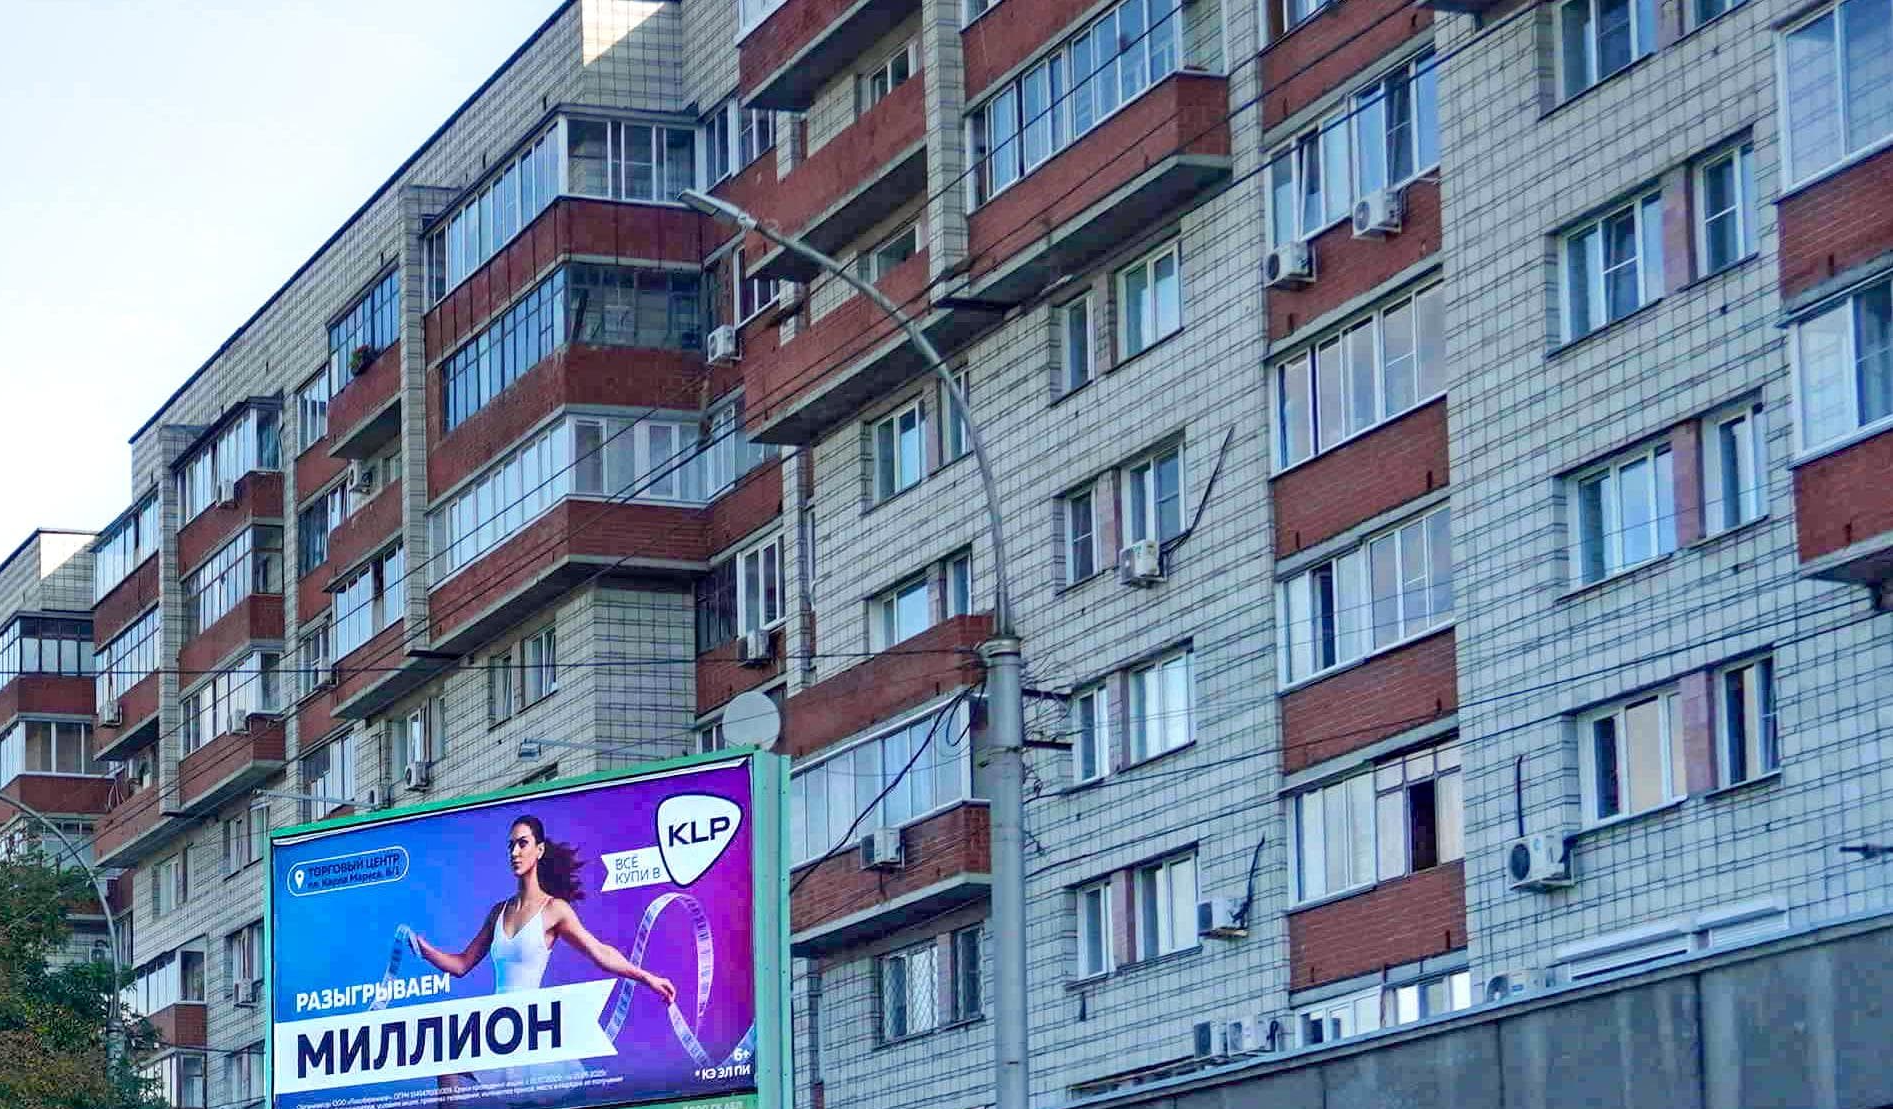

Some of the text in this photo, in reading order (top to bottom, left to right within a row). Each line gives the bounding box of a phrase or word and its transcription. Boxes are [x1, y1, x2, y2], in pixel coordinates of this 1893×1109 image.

[668, 816, 731, 847] KLP
[308, 852, 400, 877] ТОРГОВЫЙ ЦЕНТР
[615, 856, 639, 870] ВСЕ
[615, 869, 649, 885] КУПИ
[296, 972, 451, 1013] РАЗЫГРЫВАЕМ
[297, 1000, 562, 1080] МИЛЛИОН
